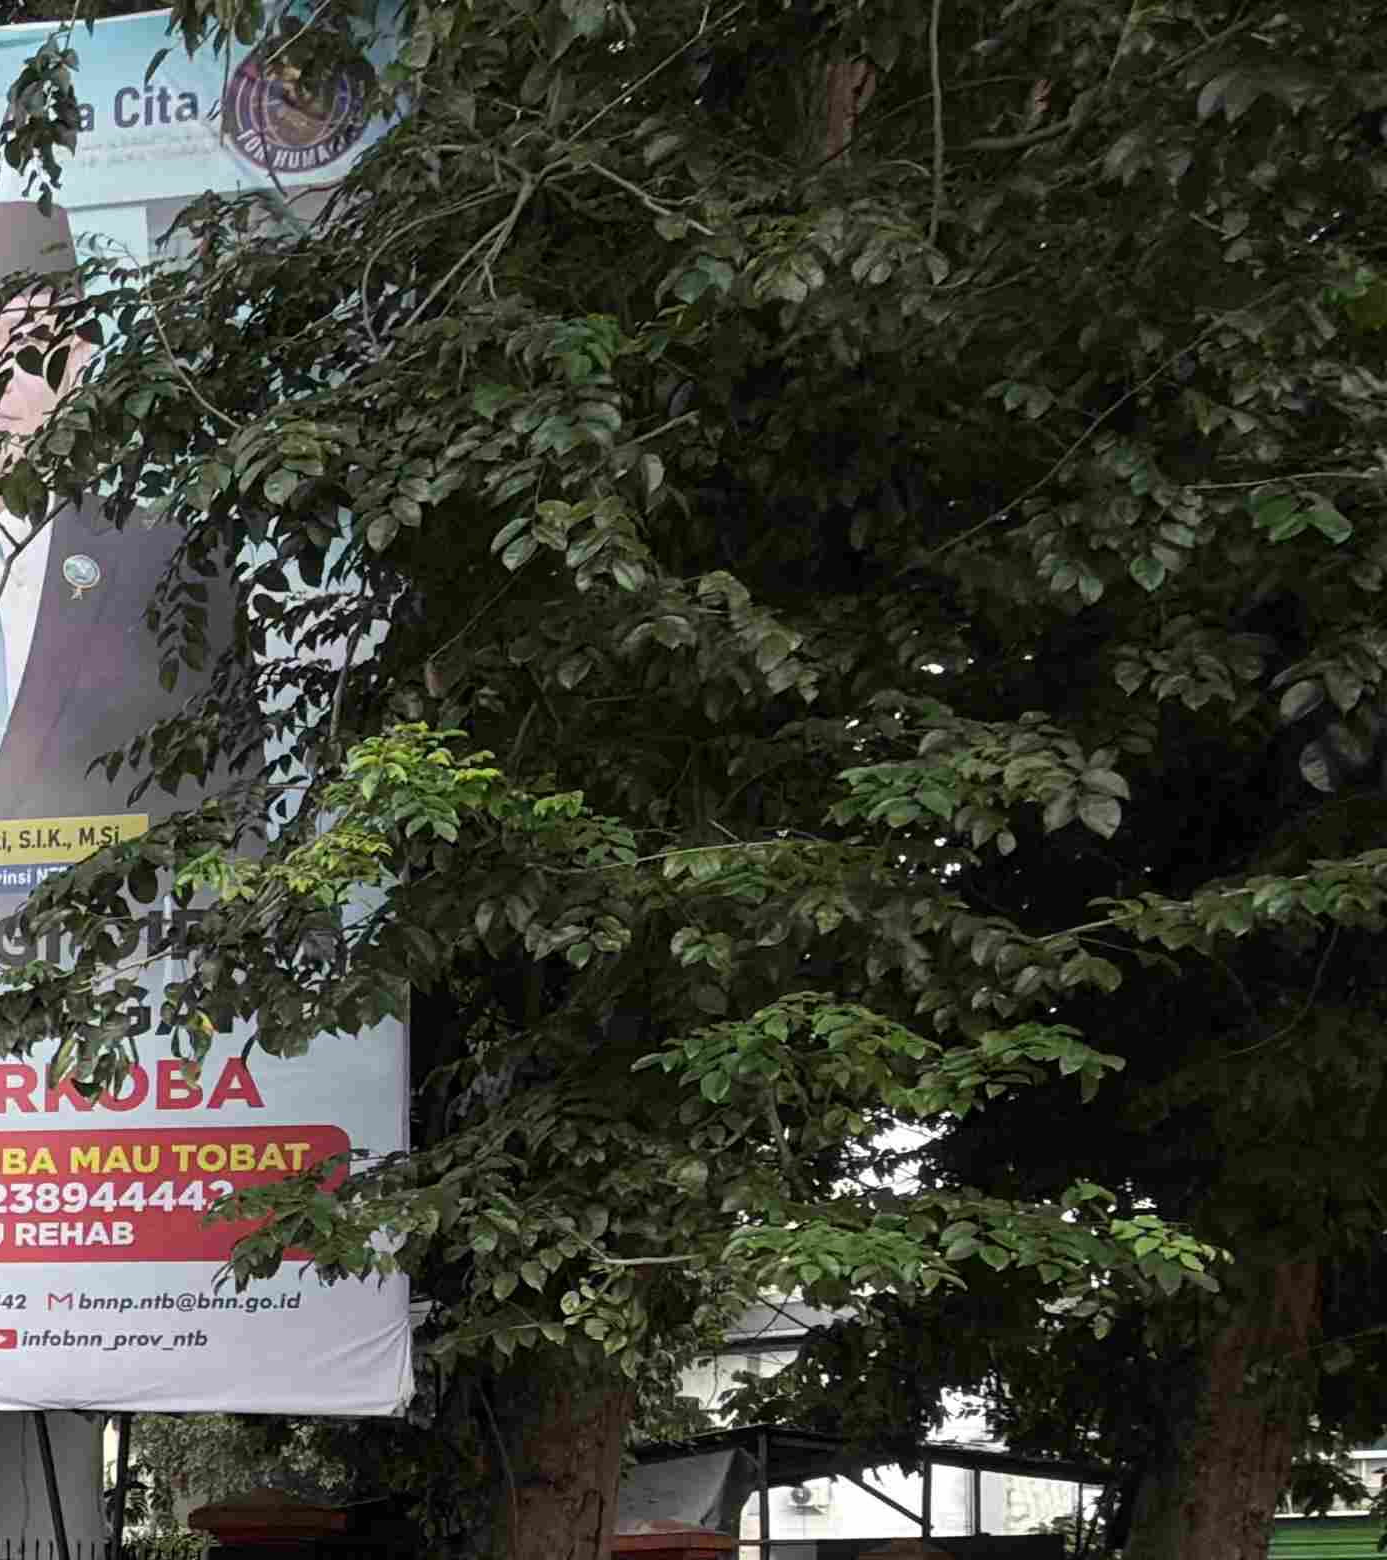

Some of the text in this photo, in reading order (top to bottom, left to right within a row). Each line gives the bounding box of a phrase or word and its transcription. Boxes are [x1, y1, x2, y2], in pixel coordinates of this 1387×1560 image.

[114, 83, 198, 129] Cita
[70, 1146, 160, 1175] MAU
[171, 1143, 311, 1172] TOBAT
[15, 1221, 134, 1246] REHAB
[79, 1292, 301, 1312] bnnp.ntb@bnn.go.id
[21, 1330, 208, 1351] infobnn_prov_ntb
